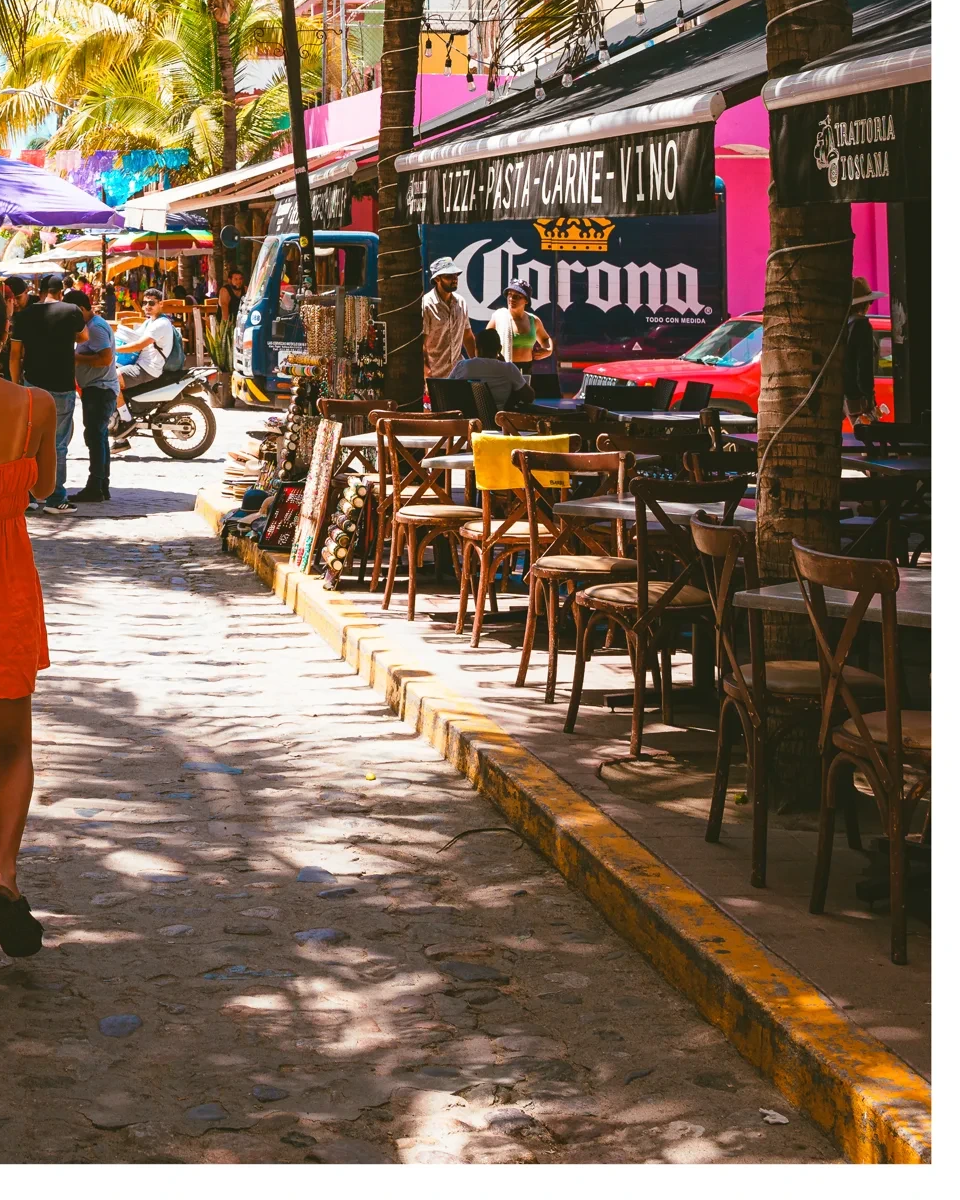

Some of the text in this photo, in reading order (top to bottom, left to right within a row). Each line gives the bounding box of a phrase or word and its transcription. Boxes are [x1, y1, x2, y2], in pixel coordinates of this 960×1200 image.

[834, 114, 896, 147] TRATTORIA
[840, 151, 890, 181] TOSCANA
[453, 236, 706, 321] Corona
[680, 317, 706, 325] MEDIDA
